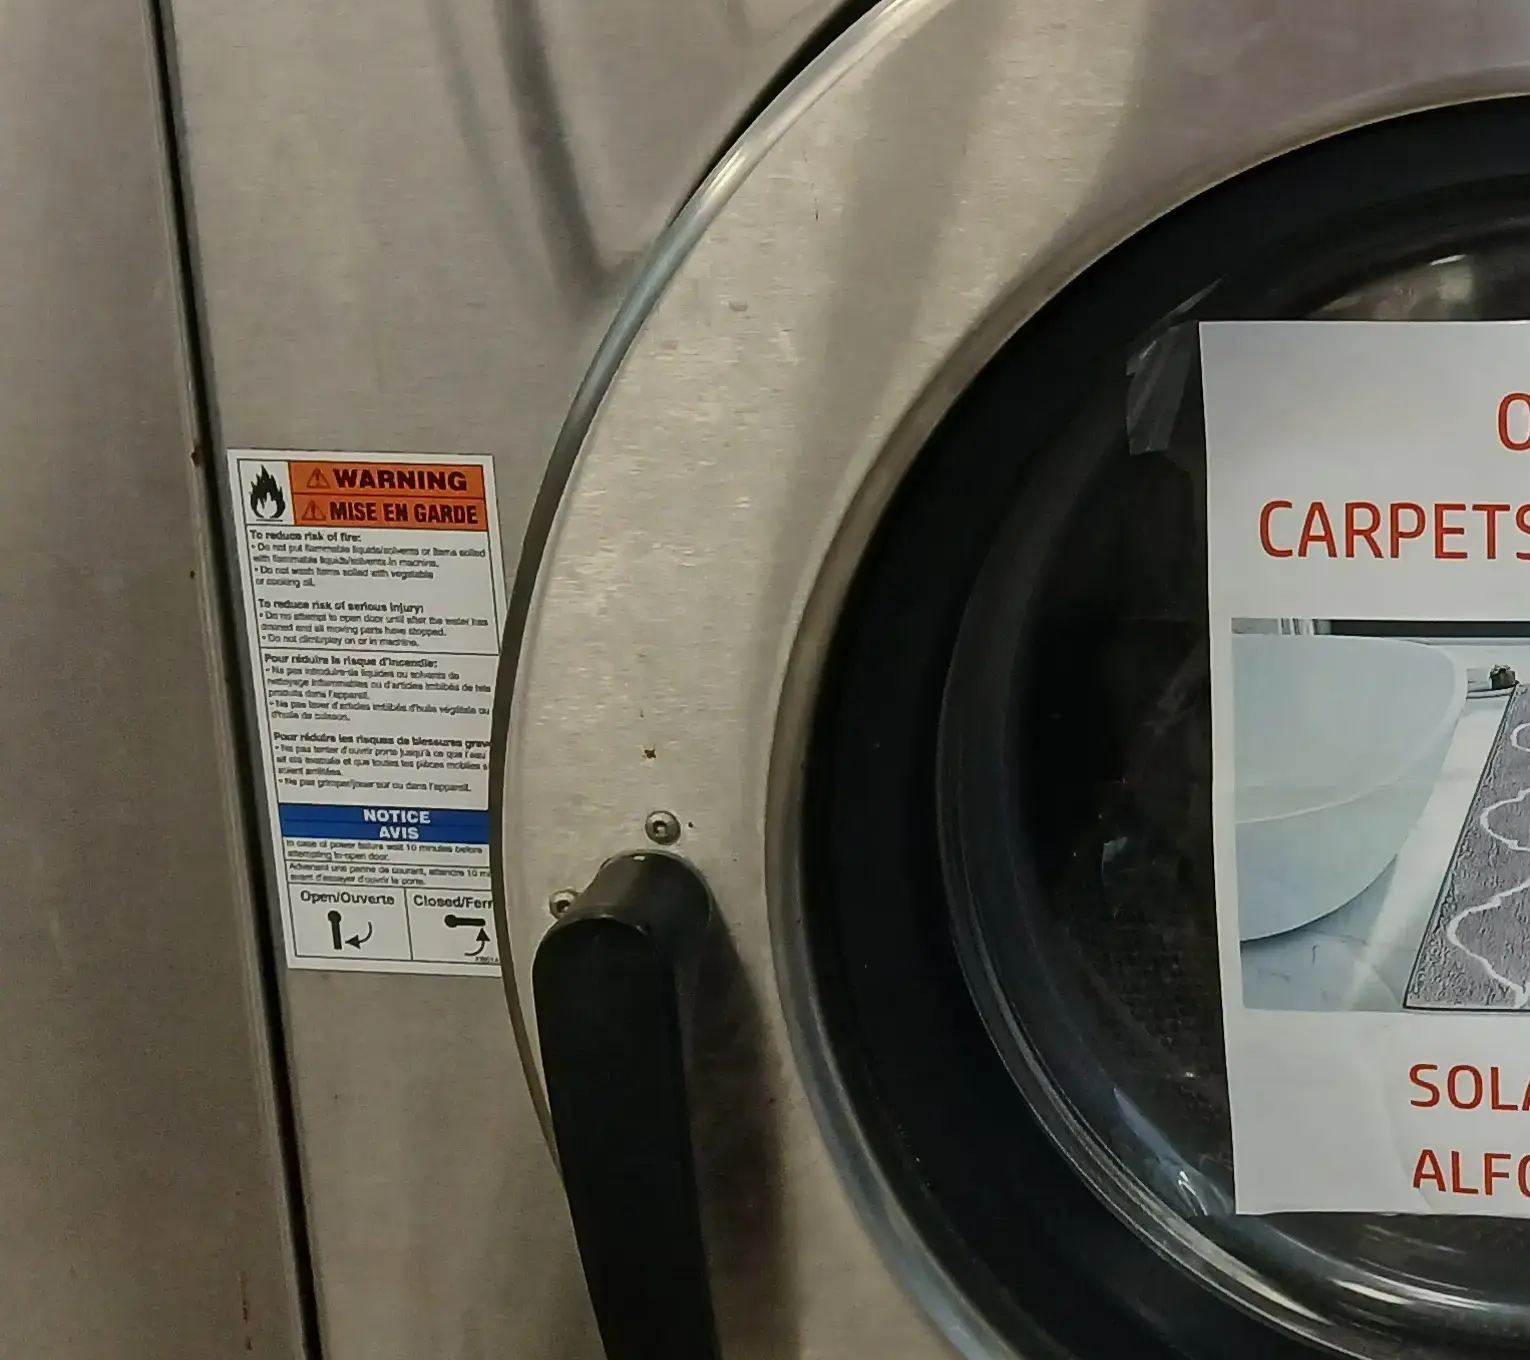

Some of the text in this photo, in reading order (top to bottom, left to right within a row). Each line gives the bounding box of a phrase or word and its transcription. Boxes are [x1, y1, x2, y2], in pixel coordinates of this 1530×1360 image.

[332, 468, 467, 491] WARNING
[329, 501, 479, 524] MISE EN GARDE
[250, 529, 263, 540] To
[304, 531, 324, 541] risk
[327, 532, 338, 541] of
[258, 598, 271, 608] To
[312, 601, 332, 610] risk
[334, 601, 345, 610] of
[347, 602, 387, 612] serious
[363, 809, 431, 824] NOTICE
[379, 826, 419, 839] AVIS
